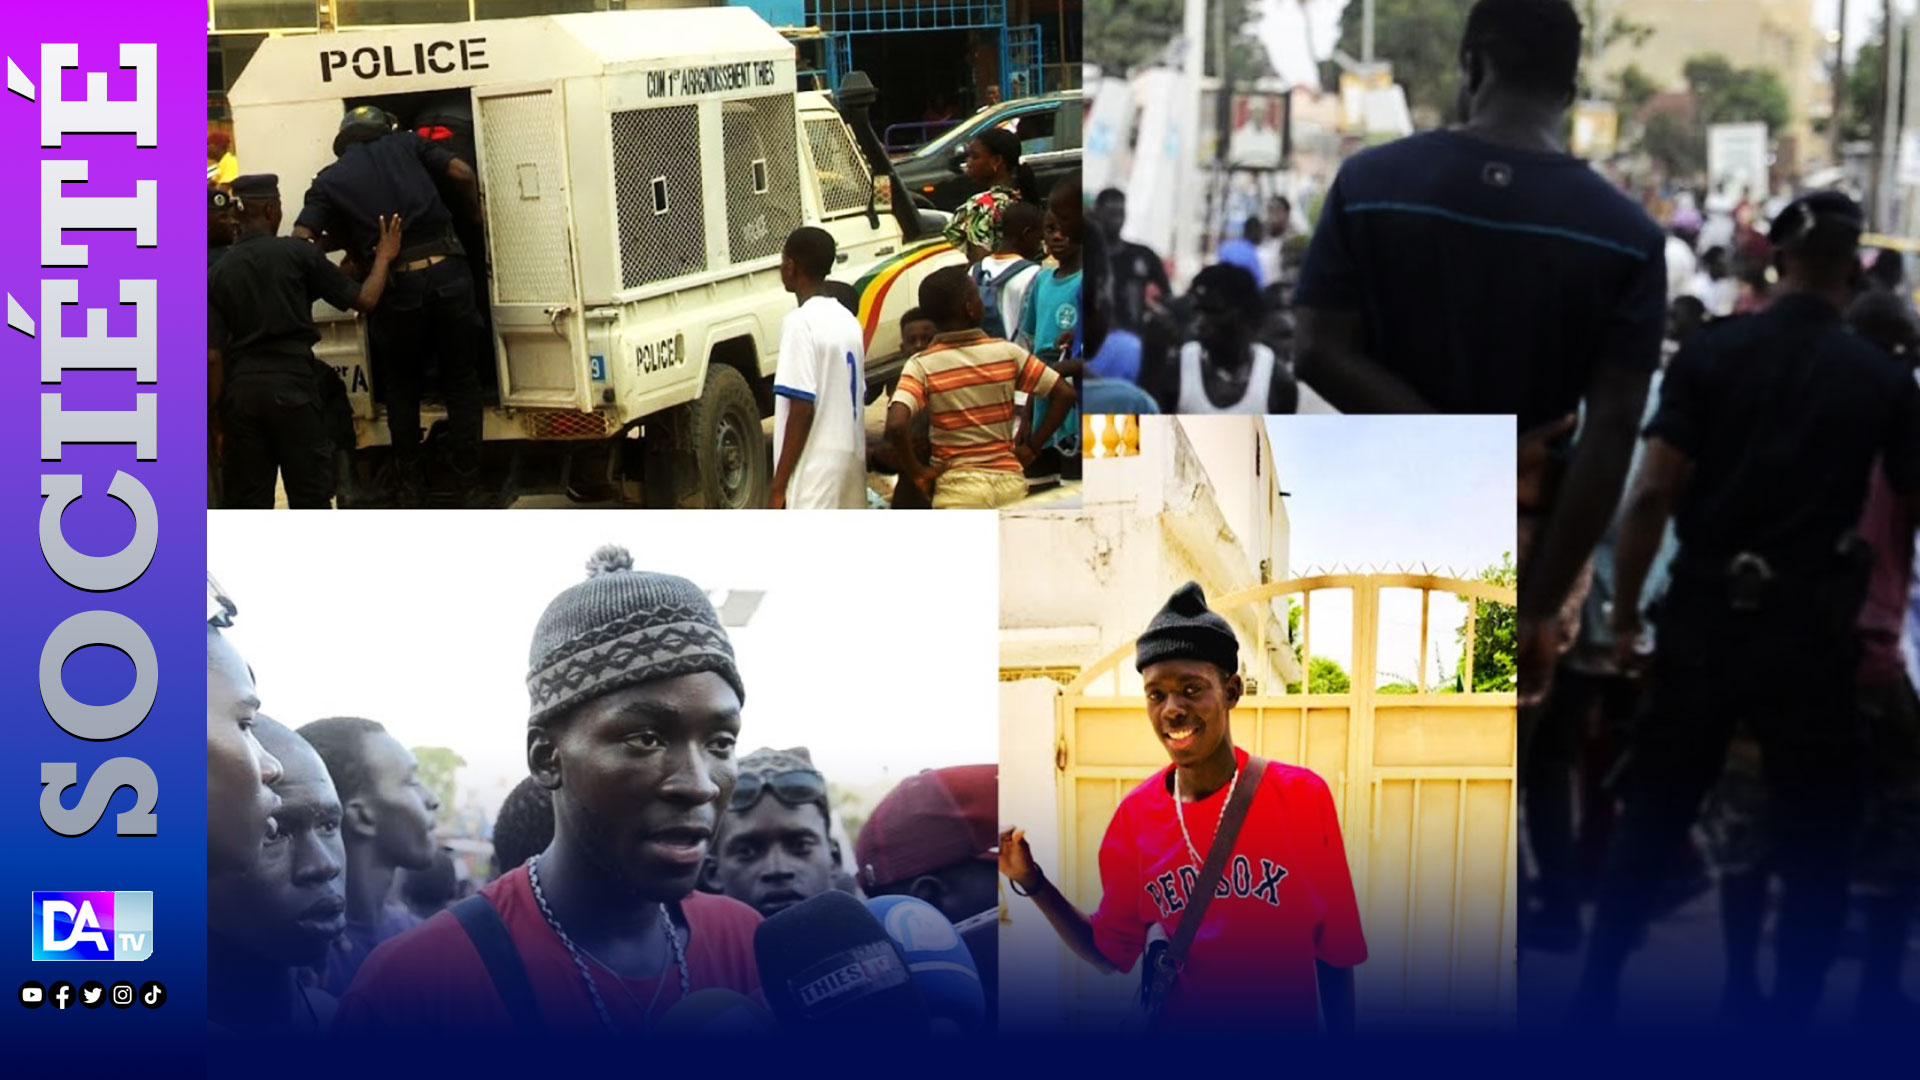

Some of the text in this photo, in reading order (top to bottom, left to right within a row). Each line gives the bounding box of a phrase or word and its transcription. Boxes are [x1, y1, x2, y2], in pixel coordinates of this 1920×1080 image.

[320, 37, 490, 82] POLICE
[647, 70, 665, 98] COM
[753, 60, 775, 87] THIES
[636, 337, 674, 376] POLICE
